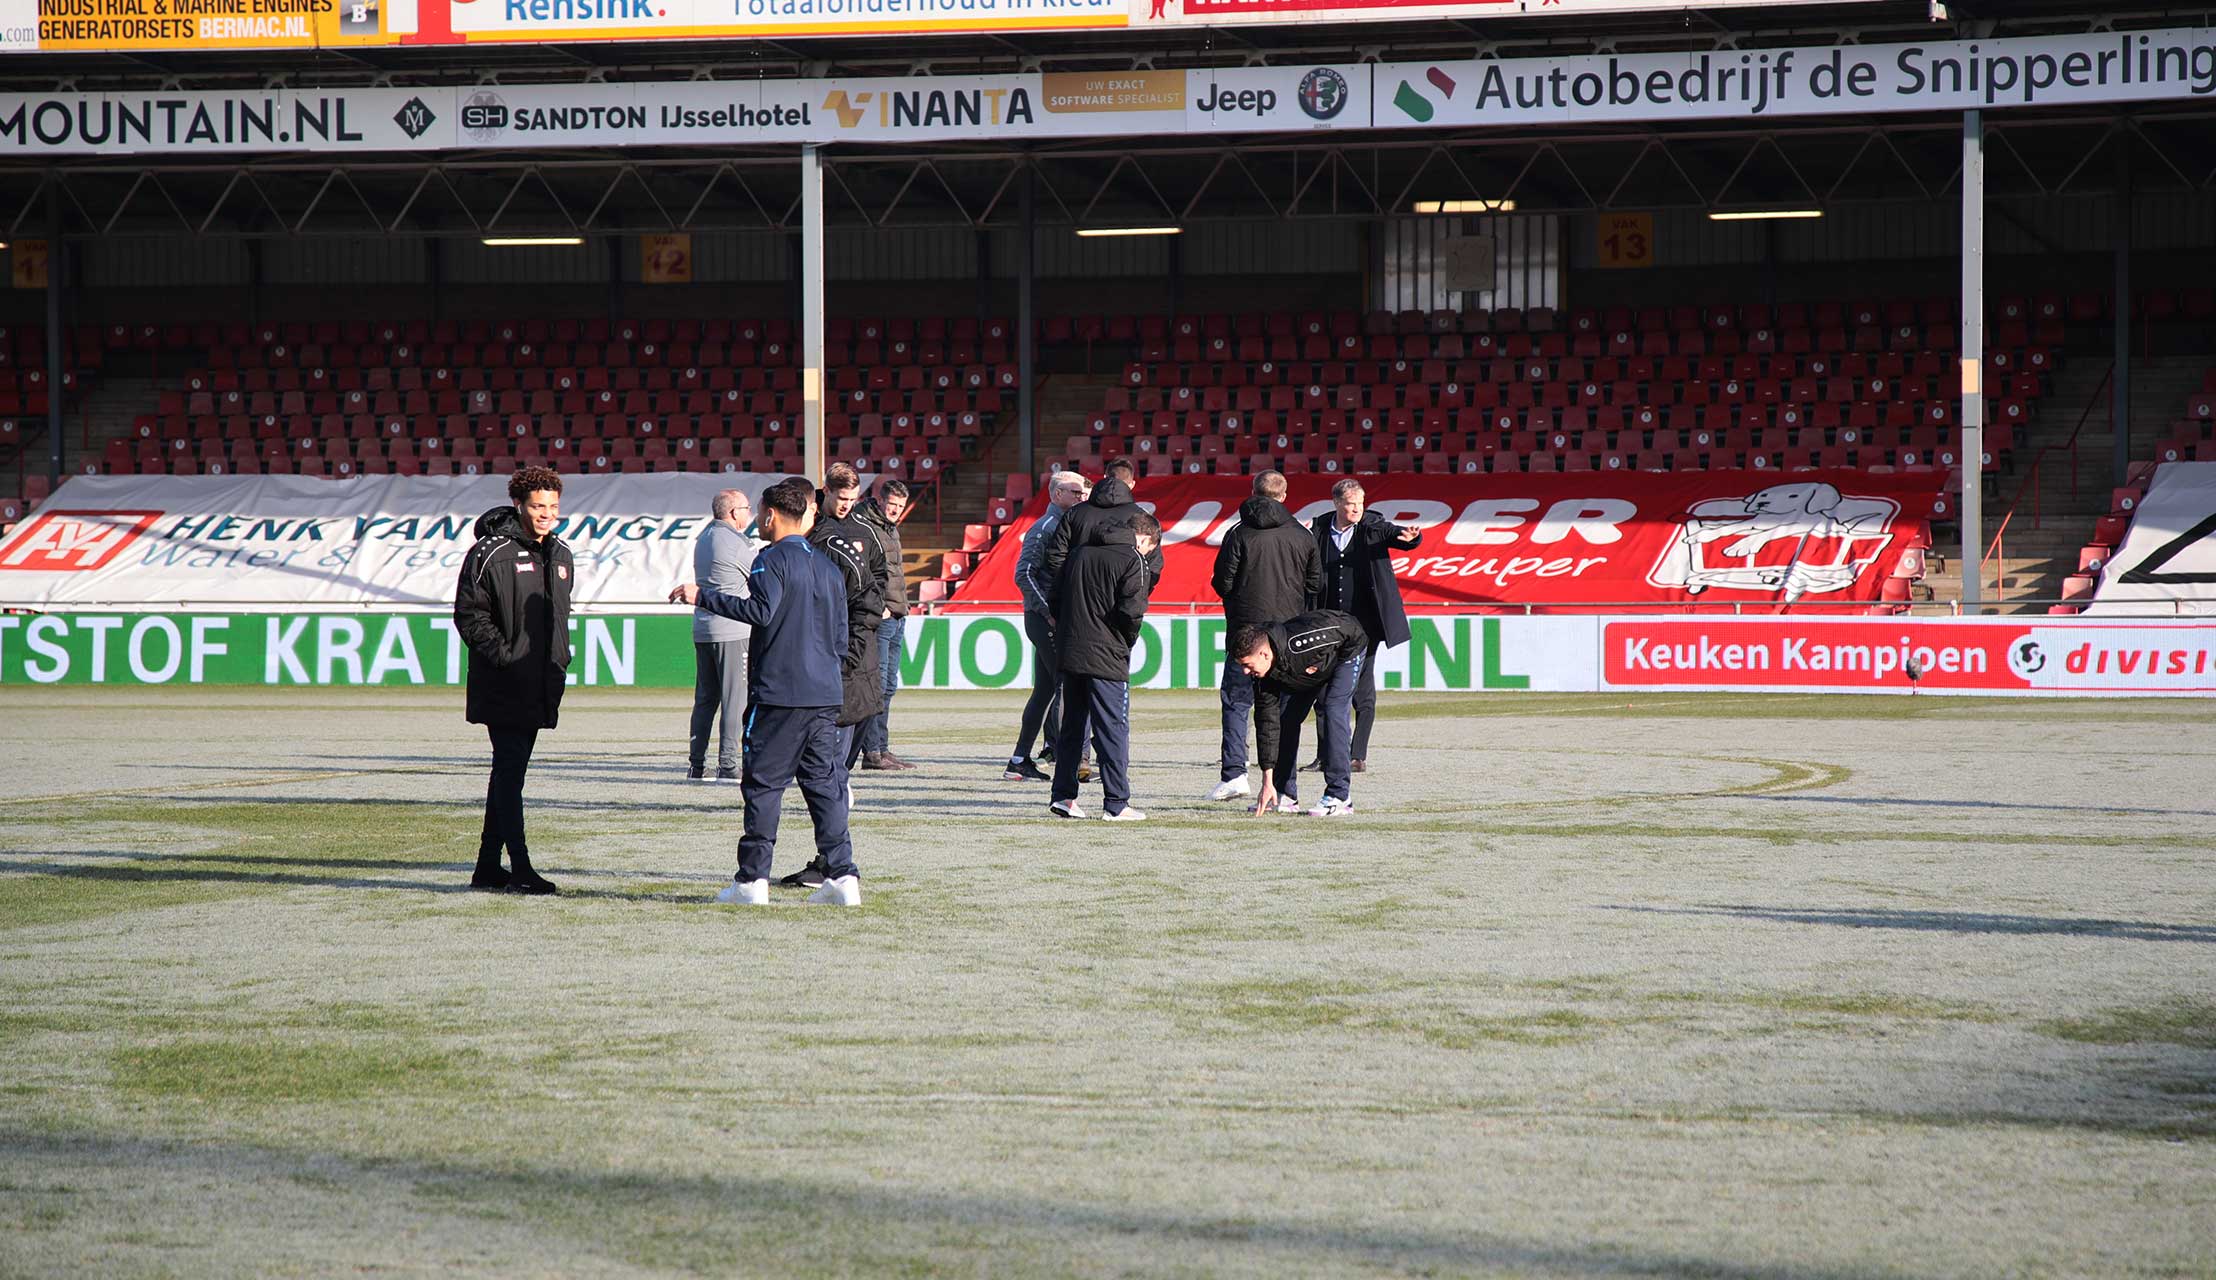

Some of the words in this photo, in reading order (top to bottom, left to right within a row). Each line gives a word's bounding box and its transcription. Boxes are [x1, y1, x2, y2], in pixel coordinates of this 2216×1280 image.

[0, 27, 34, 42] .com
[39, 19, 194, 40] GENERATORSETS
[200, 16, 310, 38] BERMAC.NL
[1108, 79, 1146, 91] EXACT
[1475, 51, 1794, 114] Autobedrijf
[1809, 49, 1877, 98] de
[1051, 95, 1114, 106] SOFTWARE
[1118, 92, 1181, 105] SPECIALIST
[1197, 83, 1276, 116] Jeep
[514, 106, 646, 131] SANDTON
[661, 102, 811, 128] IJsselhotel
[1604, 233, 1648, 260] 13
[648, 249, 689, 275] 12
[163, 515, 339, 541] HENK
[353, 515, 473, 541] VAN
[140, 542, 309, 568] Water
[318, 545, 357, 567] &
[1626, 635, 1769, 669] Keuken
[1783, 636, 1987, 679] Kampioen
[2066, 643, 2216, 675] divisi
